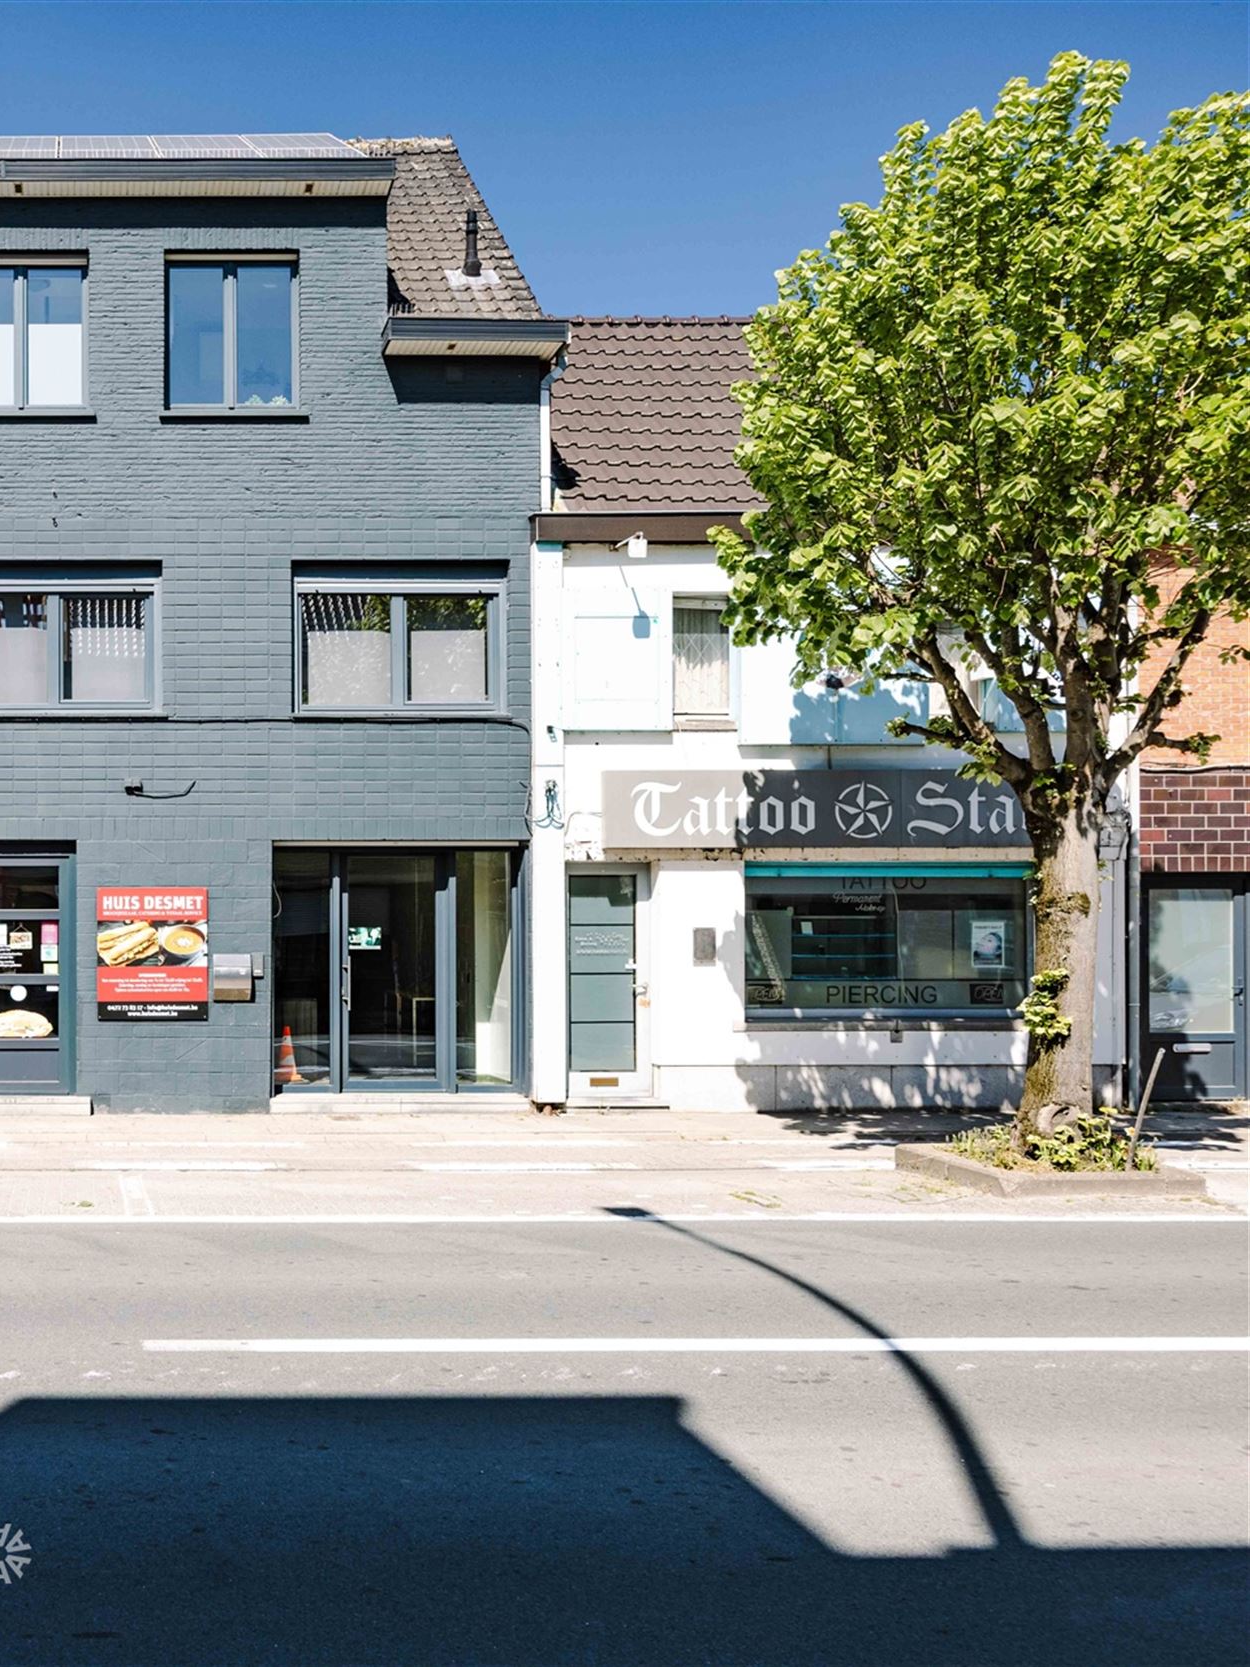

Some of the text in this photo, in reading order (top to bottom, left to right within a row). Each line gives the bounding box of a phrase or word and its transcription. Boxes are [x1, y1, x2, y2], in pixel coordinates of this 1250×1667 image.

[630, 779, 1027, 838] Tattoo Sta
[102, 895, 204, 910] HUIS DESMET
[826, 985, 938, 1004] PIERCING
